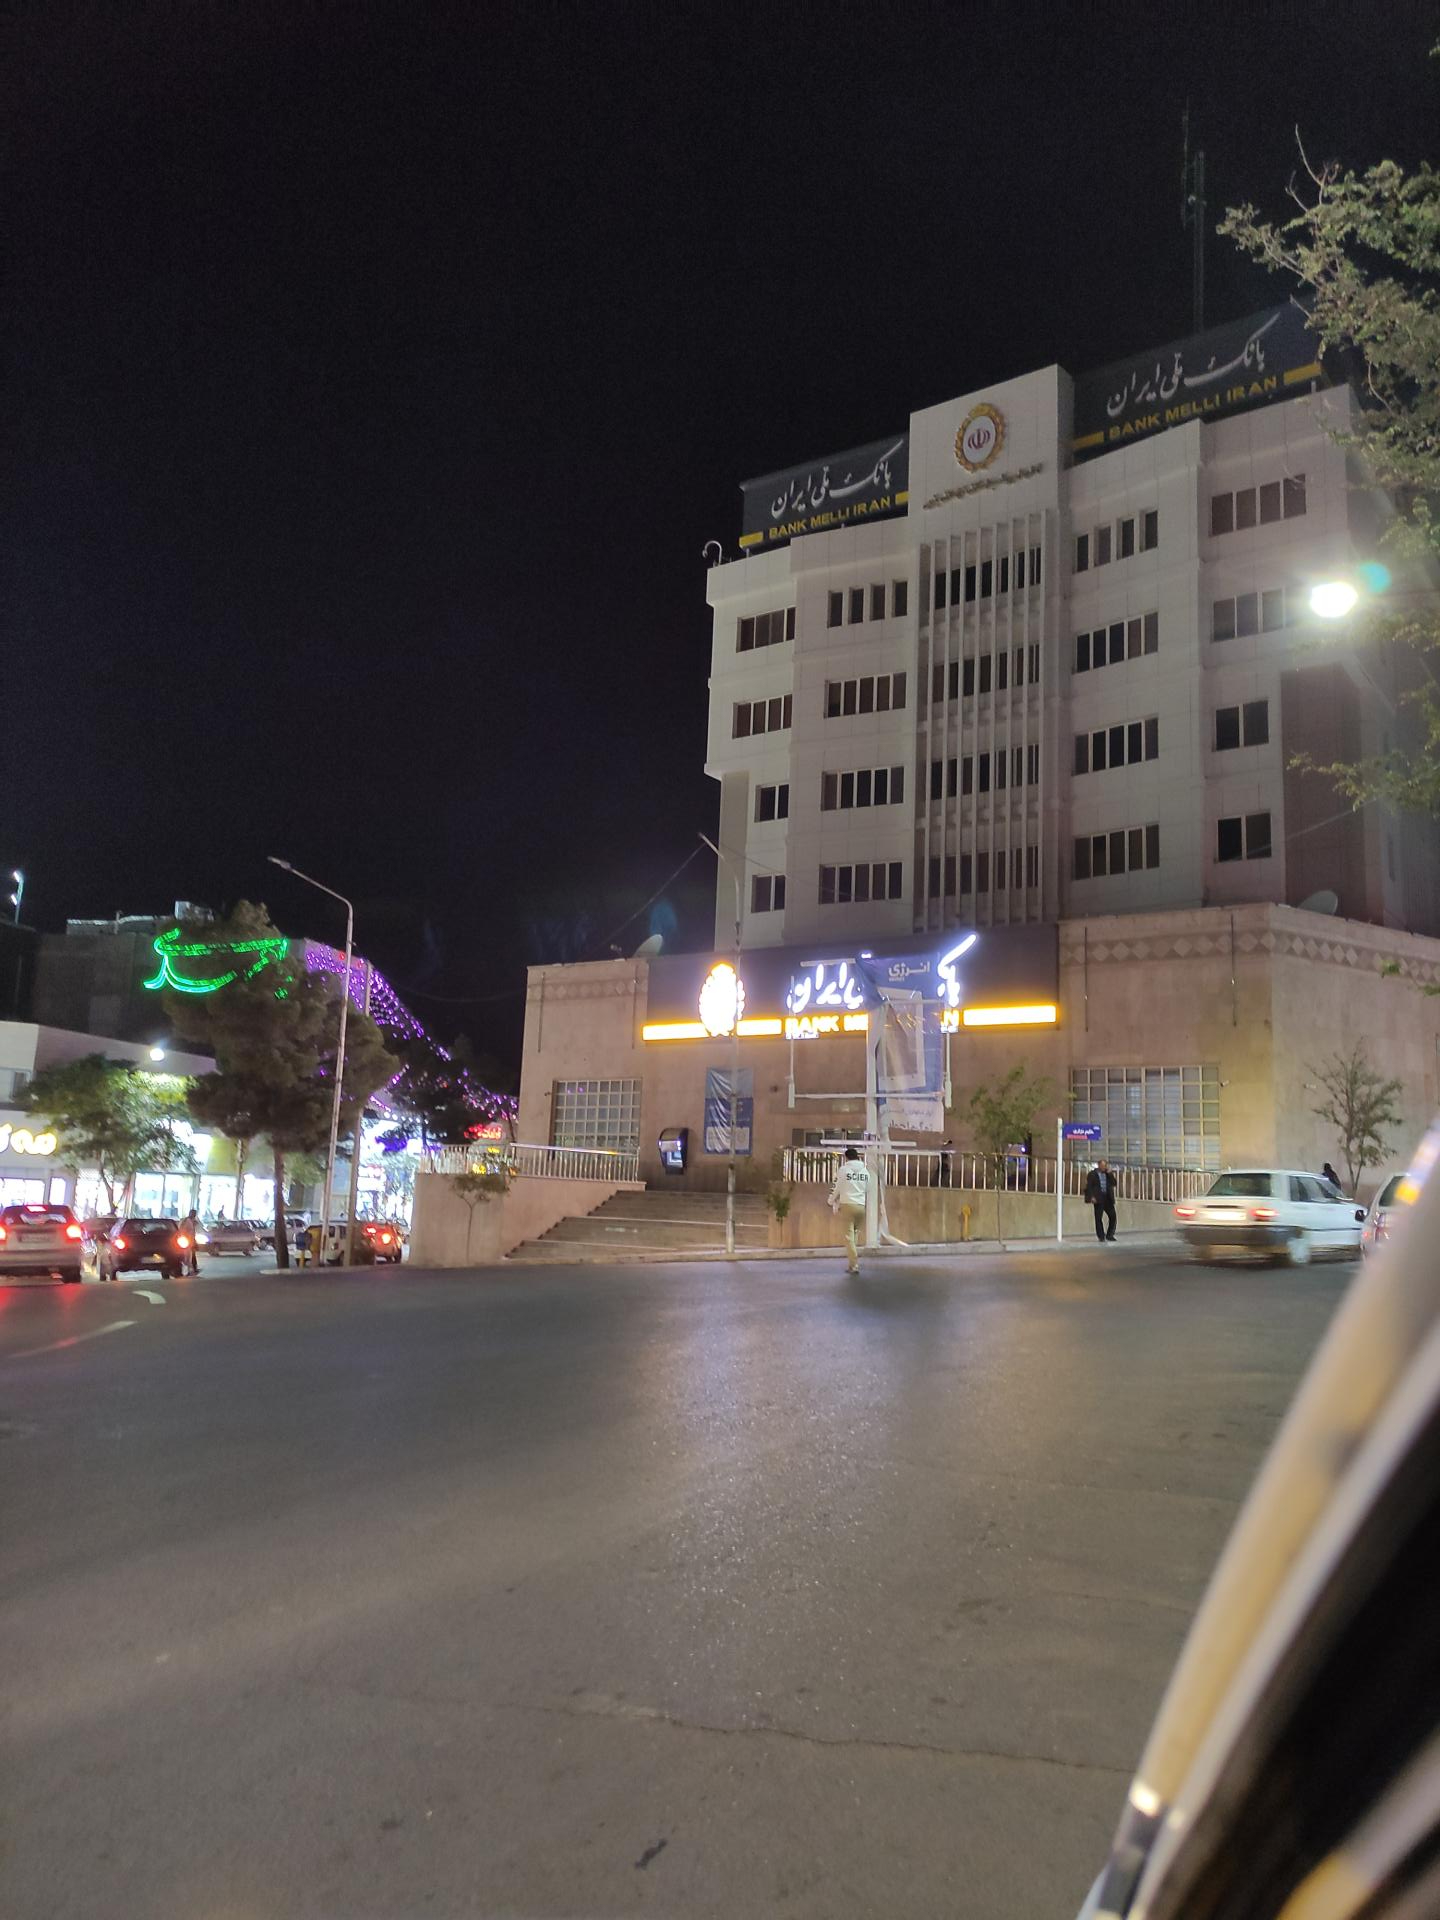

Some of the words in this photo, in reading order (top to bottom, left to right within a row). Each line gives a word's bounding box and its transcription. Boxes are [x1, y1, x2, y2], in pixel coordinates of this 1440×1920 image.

[1184, 312, 1281, 387] بانک
[1107, 363, 1160, 417] ایران
[1160, 352, 1184, 399] ملی
[1109, 415, 1161, 441] BANK
[1165, 393, 1220, 423] MELLI
[1226, 375, 1277, 404] IRAN
[811, 465, 830, 508] ملی
[829, 439, 903, 499] بانک
[768, 520, 807, 539] BANK
[810, 507, 849, 528] MELLI
[853, 496, 890, 516] IRAN
[771, 474, 812, 519] ایران
[888, 961, 930, 977] انرژی
[785, 1015, 840, 1035] BANK
